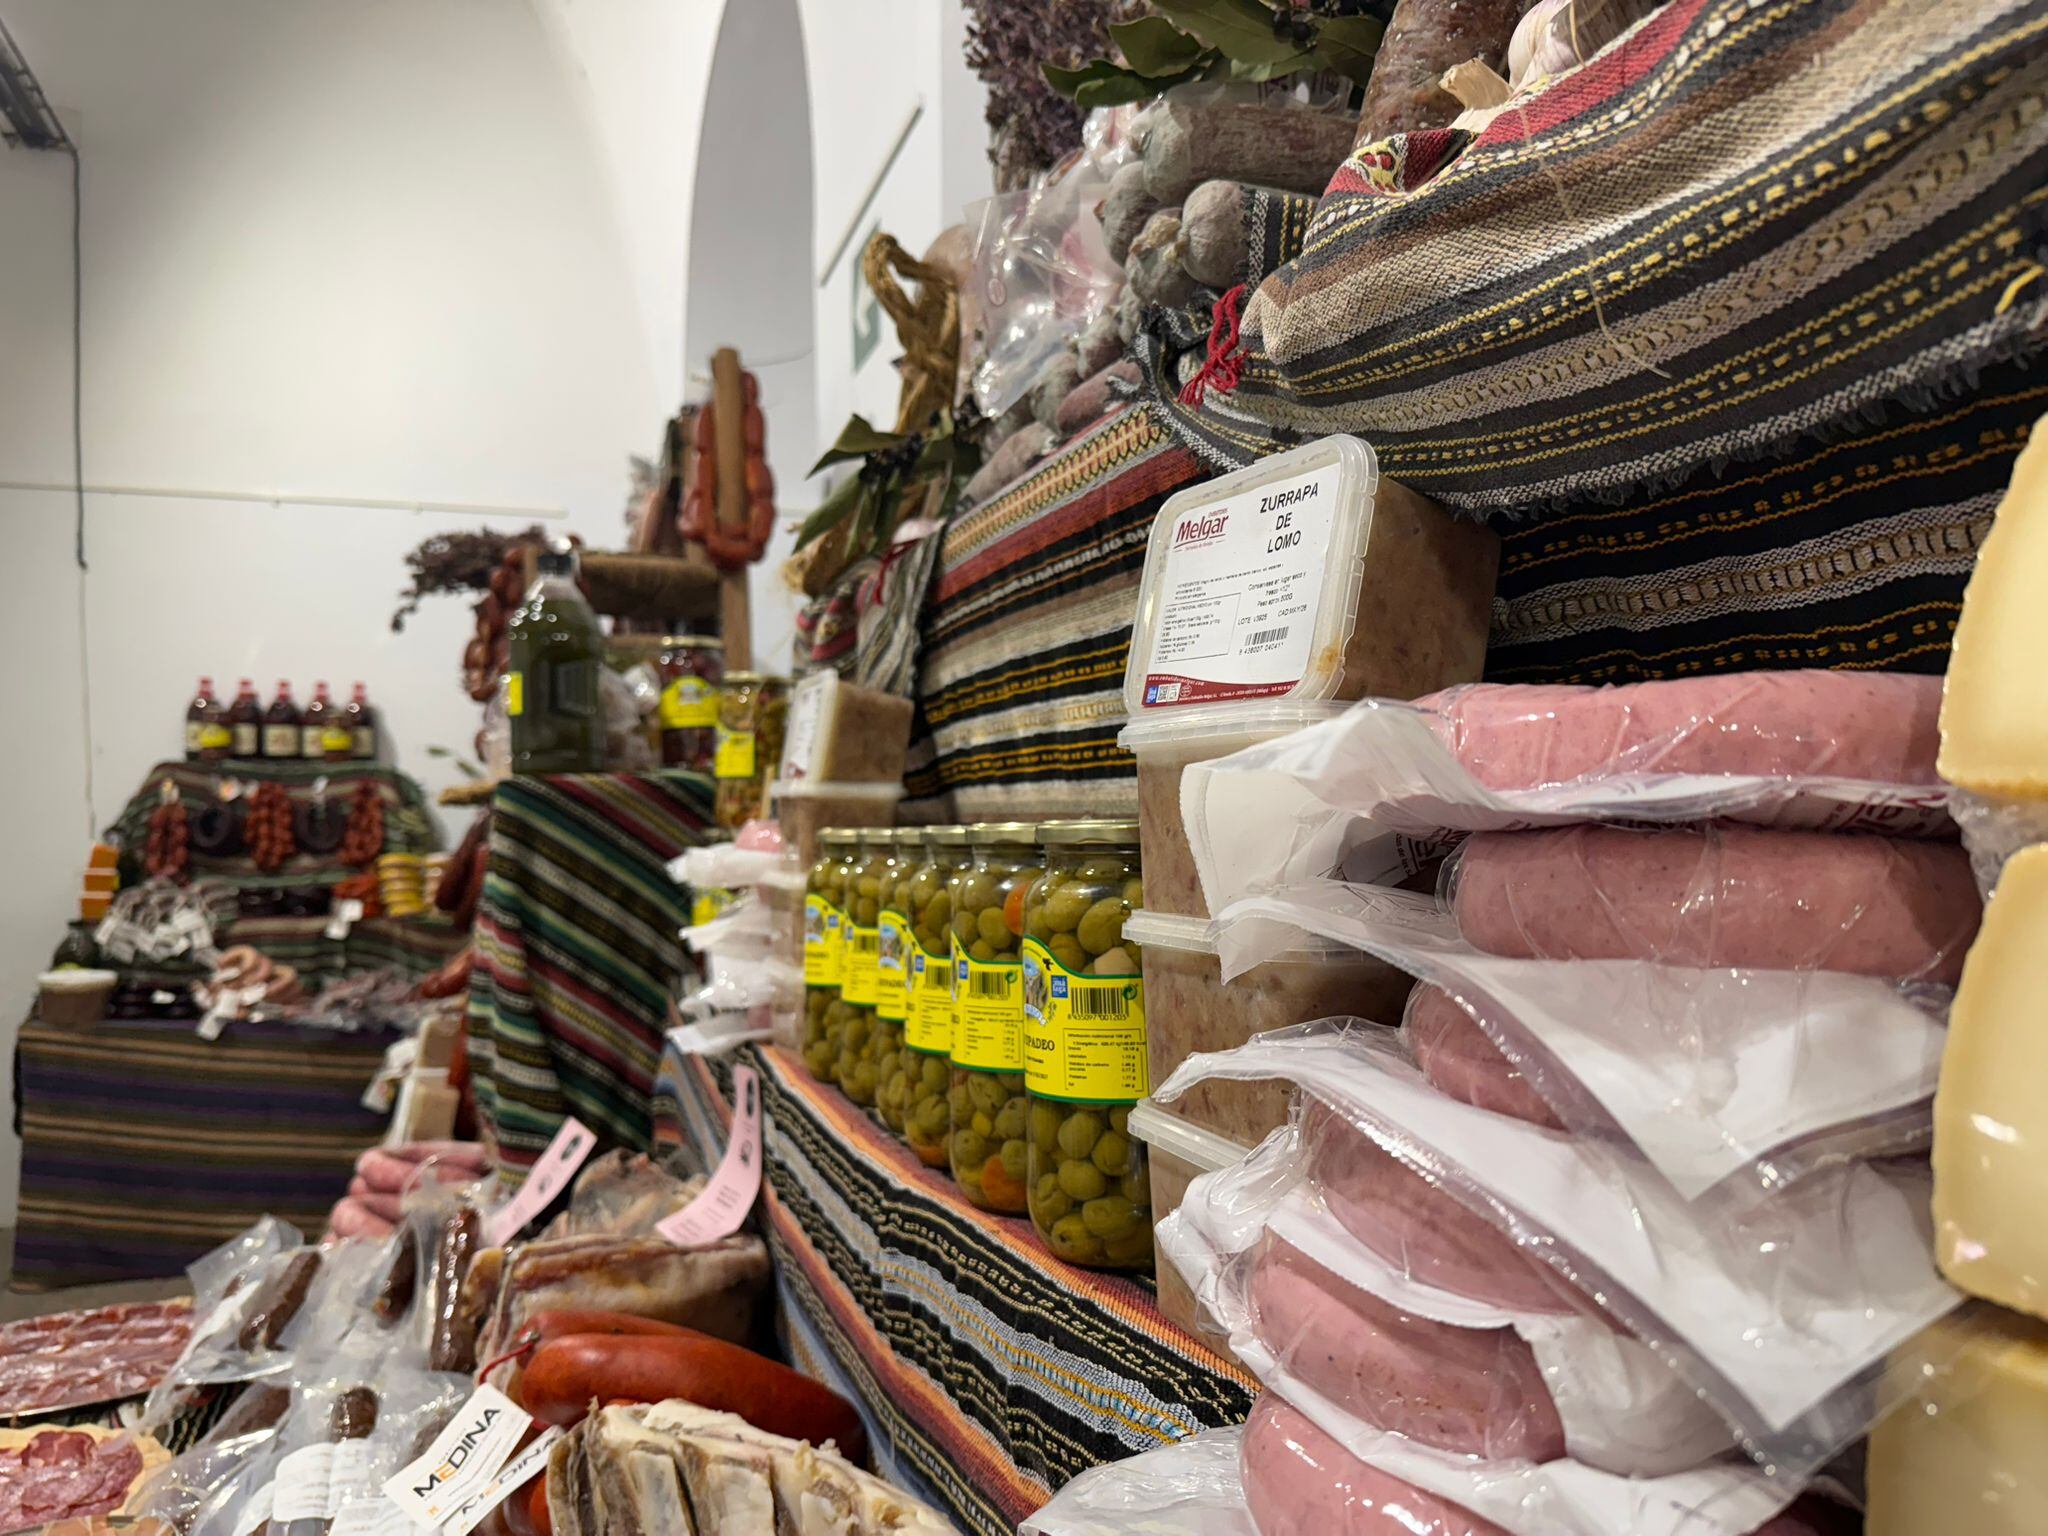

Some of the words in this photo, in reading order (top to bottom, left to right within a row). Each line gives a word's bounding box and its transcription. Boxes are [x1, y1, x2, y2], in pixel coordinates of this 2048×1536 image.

[1260, 482, 1319, 514] ZURRAPA
[1175, 513, 1230, 543] Melgar
[1275, 511, 1293, 531] DE
[1267, 530, 1302, 554] LOMO
[412, 1406, 501, 1499] MEDINA
